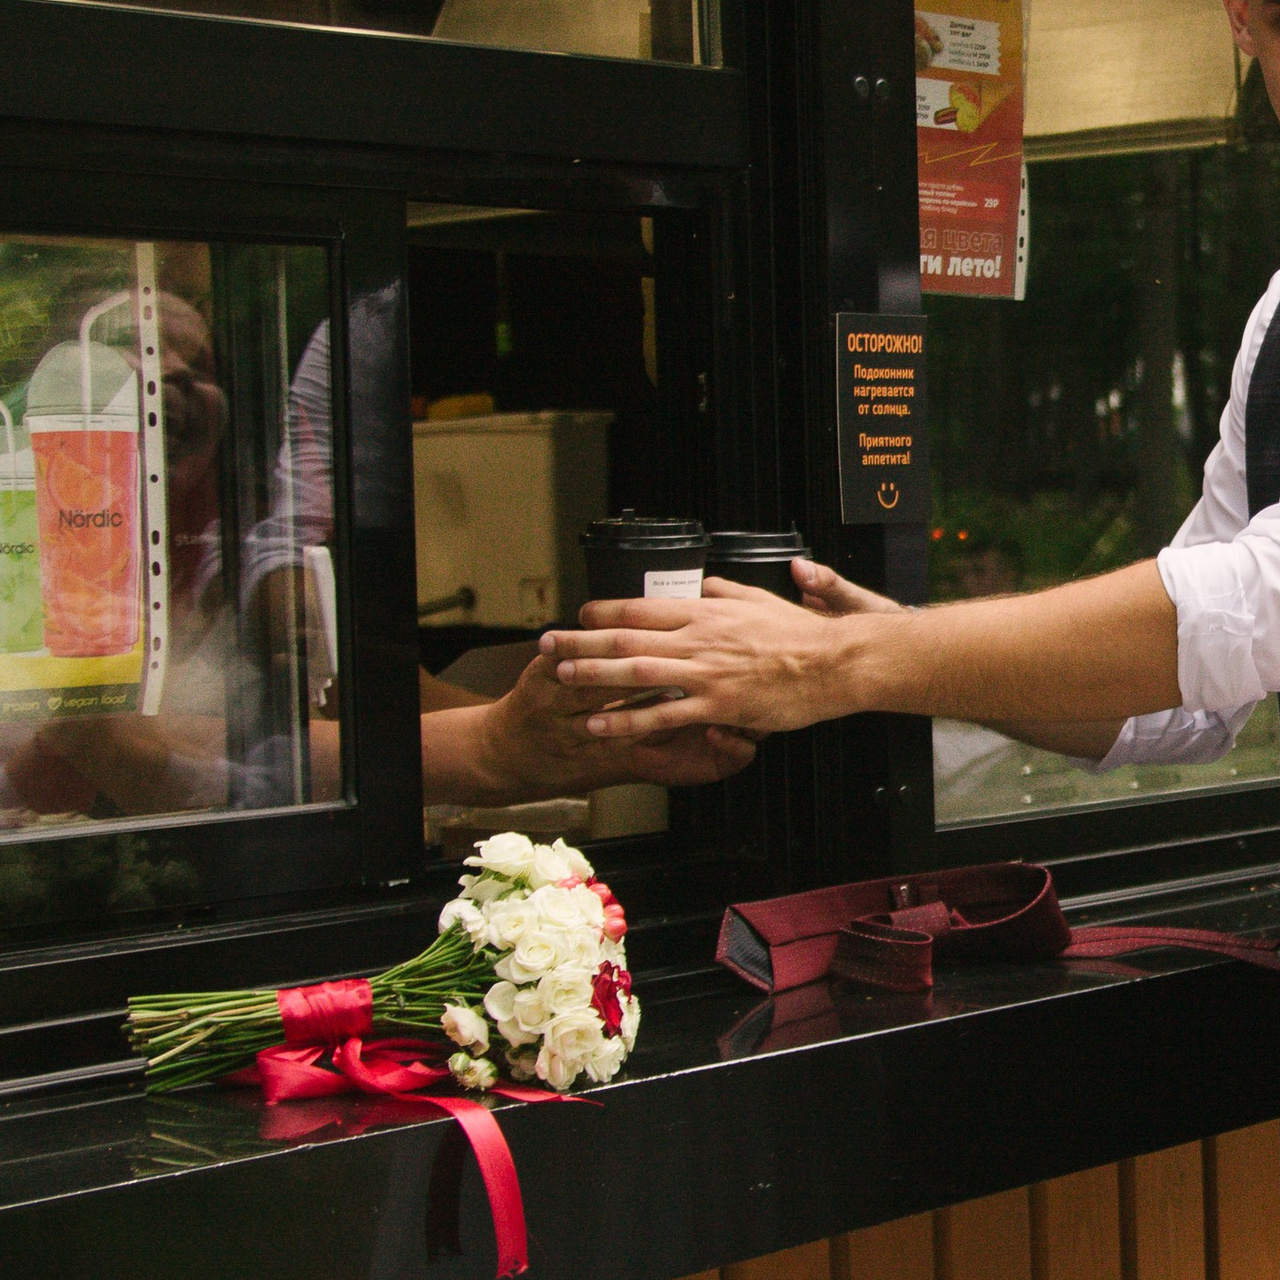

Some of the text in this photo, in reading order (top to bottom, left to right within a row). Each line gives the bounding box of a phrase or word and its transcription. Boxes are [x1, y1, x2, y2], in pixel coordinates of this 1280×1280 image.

[946, 255, 1003, 280] лето!
[847, 332, 923, 355] ОСТОРОЖНО!
[853, 363, 915, 381] Подоконник
[853, 384, 915, 401] нагревается
[858, 403, 912, 418] от солнца.
[858, 432, 913, 452] Приятного
[861, 450, 911, 467] аппетита!
